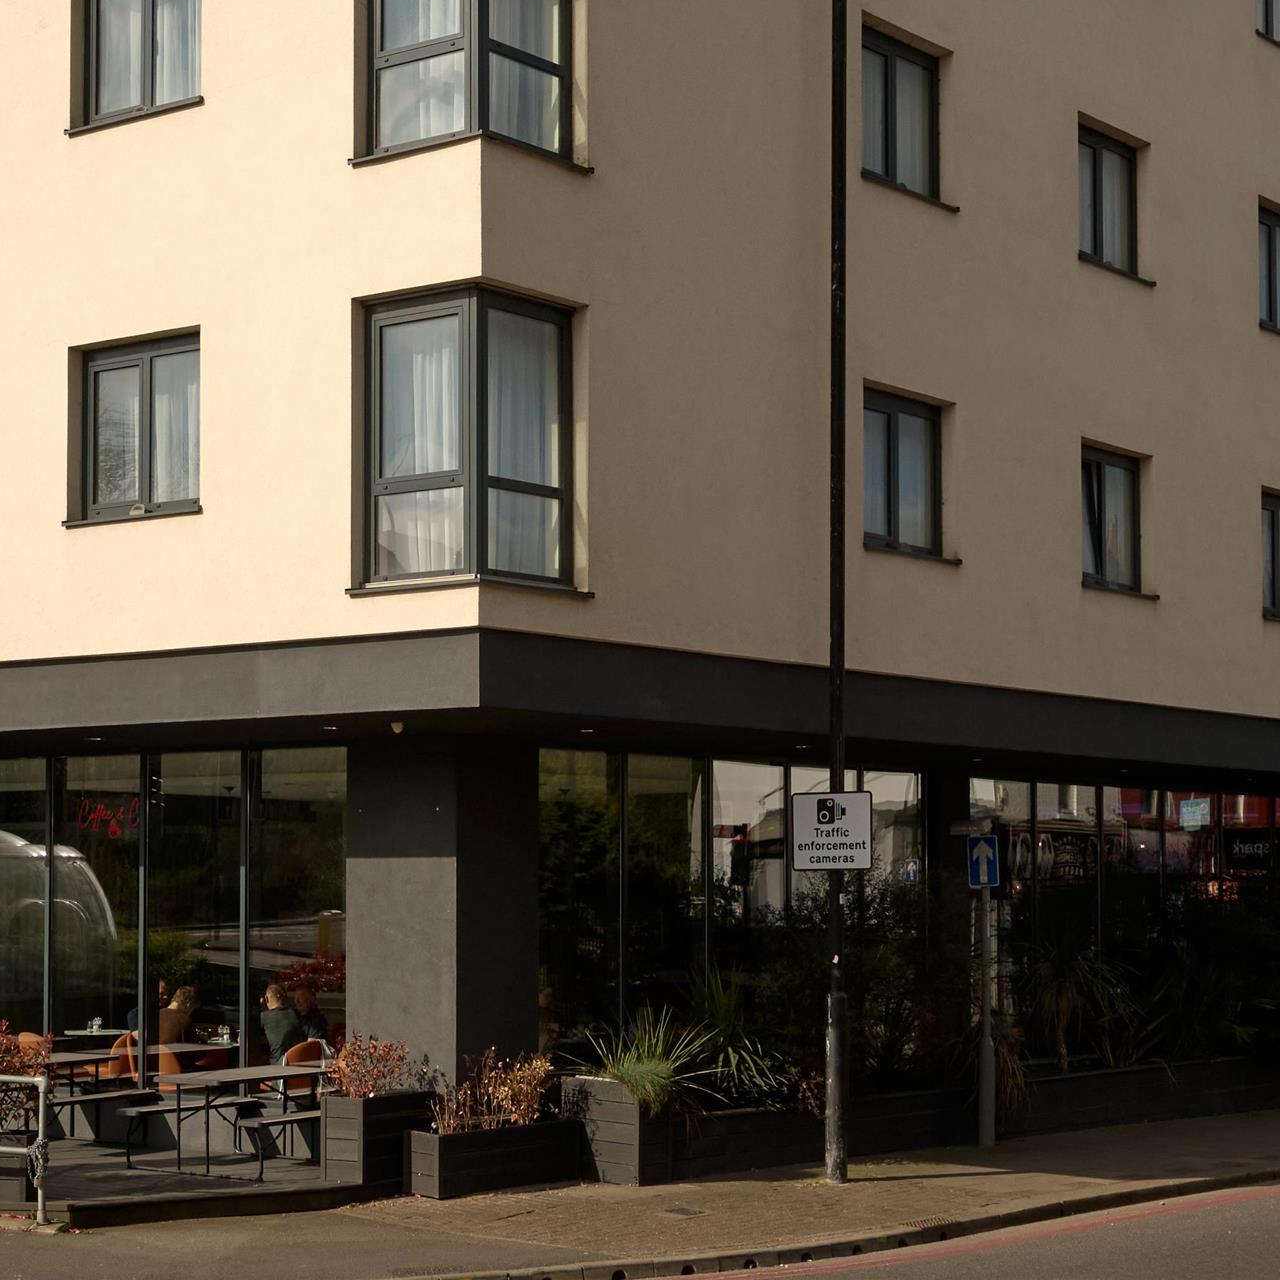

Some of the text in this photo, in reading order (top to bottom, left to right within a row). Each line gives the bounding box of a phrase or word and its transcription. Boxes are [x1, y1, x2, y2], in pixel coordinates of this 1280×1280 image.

[814, 827, 850, 838] Traffic
[797, 840, 867, 851] enforcement
[809, 855, 855, 864] cameras
